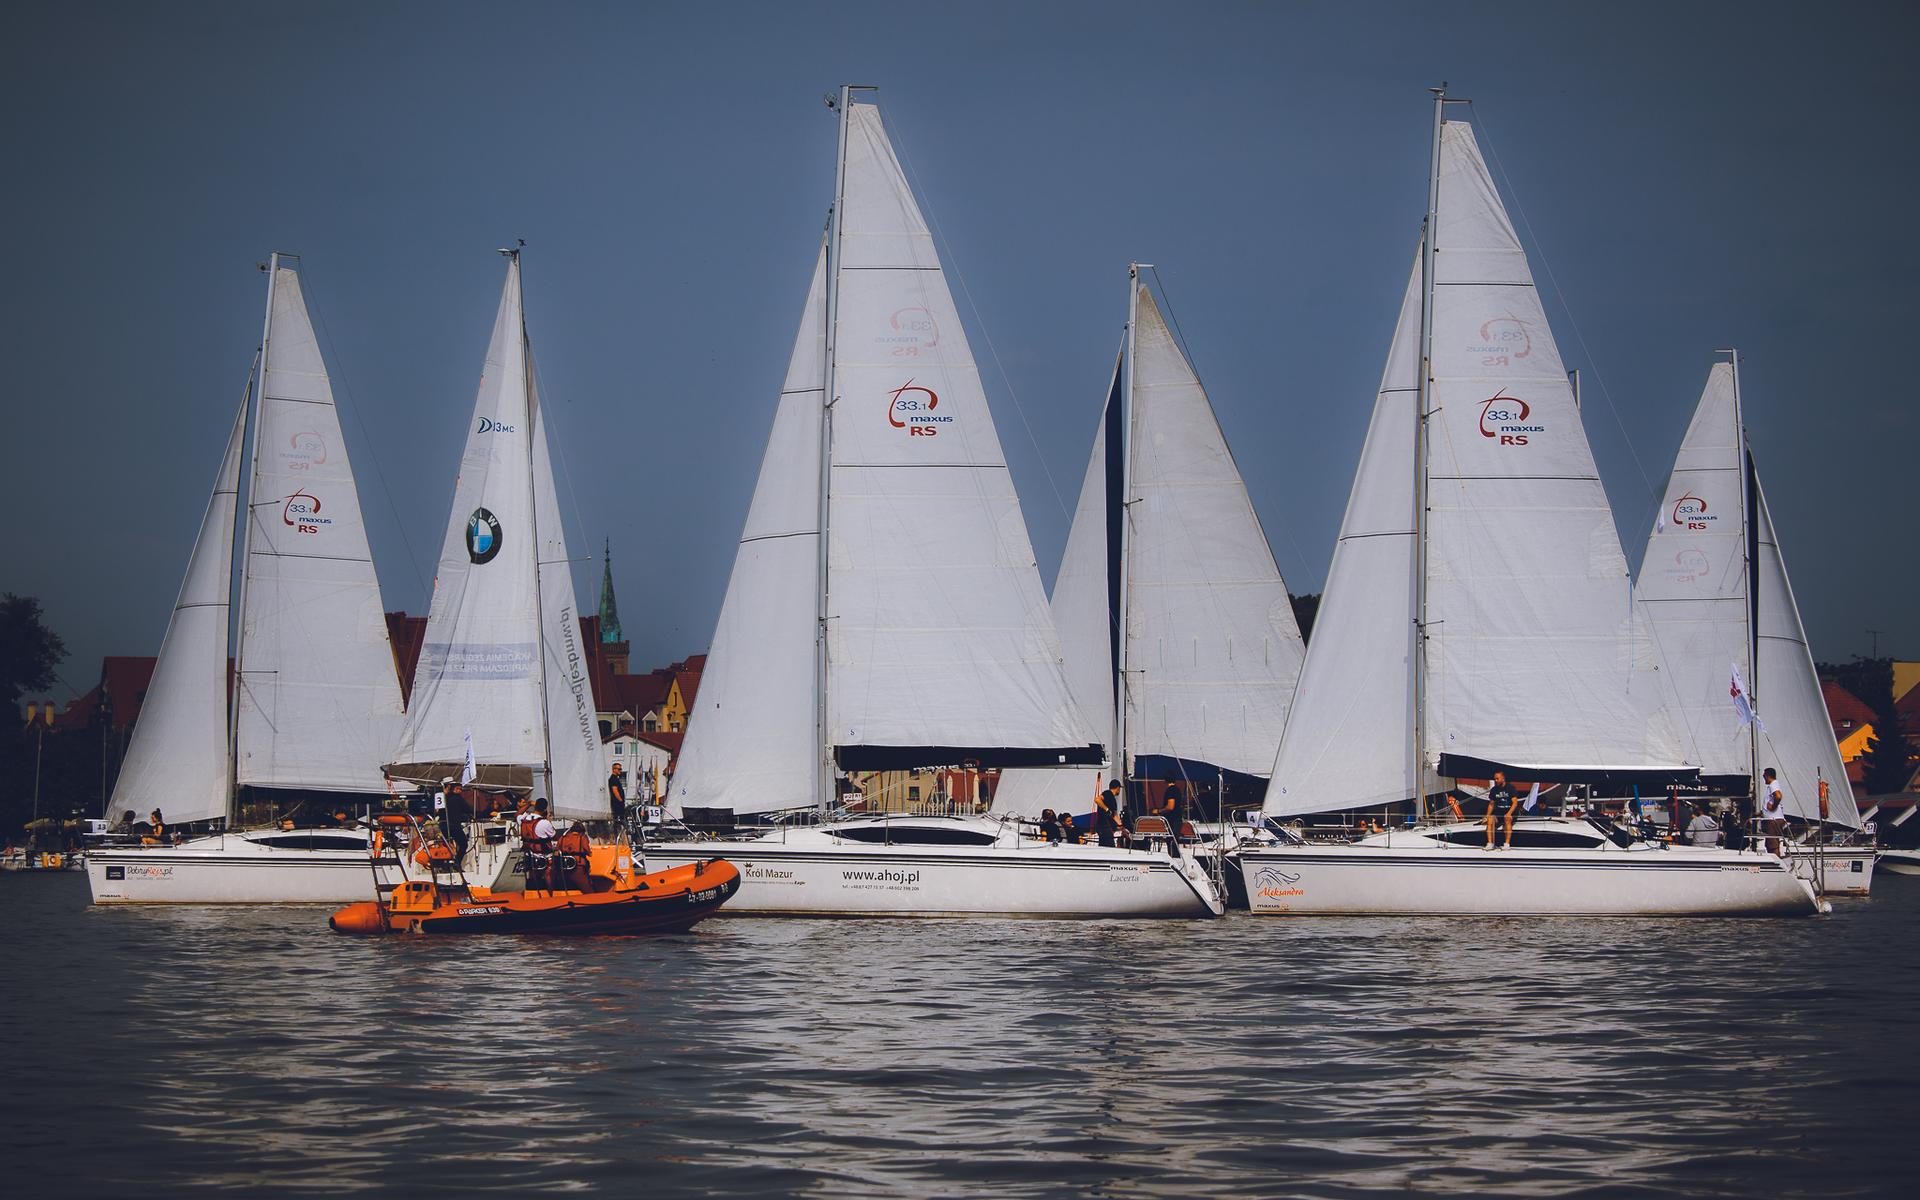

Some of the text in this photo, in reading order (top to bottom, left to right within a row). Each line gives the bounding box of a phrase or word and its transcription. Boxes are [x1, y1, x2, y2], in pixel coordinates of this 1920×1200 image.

[896, 400, 927, 411] 33.1
[1487, 410, 1518, 421] 33.1
[910, 426, 937, 436] RS
[1500, 436, 1529, 446] RS
[290, 504, 313, 513] 33.1
[298, 525, 318, 534] RS
[1688, 522, 1707, 530] RS
[649, 809, 660, 817] 15
[745, 868, 794, 878] Król Mazur
[842, 869, 920, 884] www.ahoj.pl
[1257, 886, 1305, 897] Aleksandra
